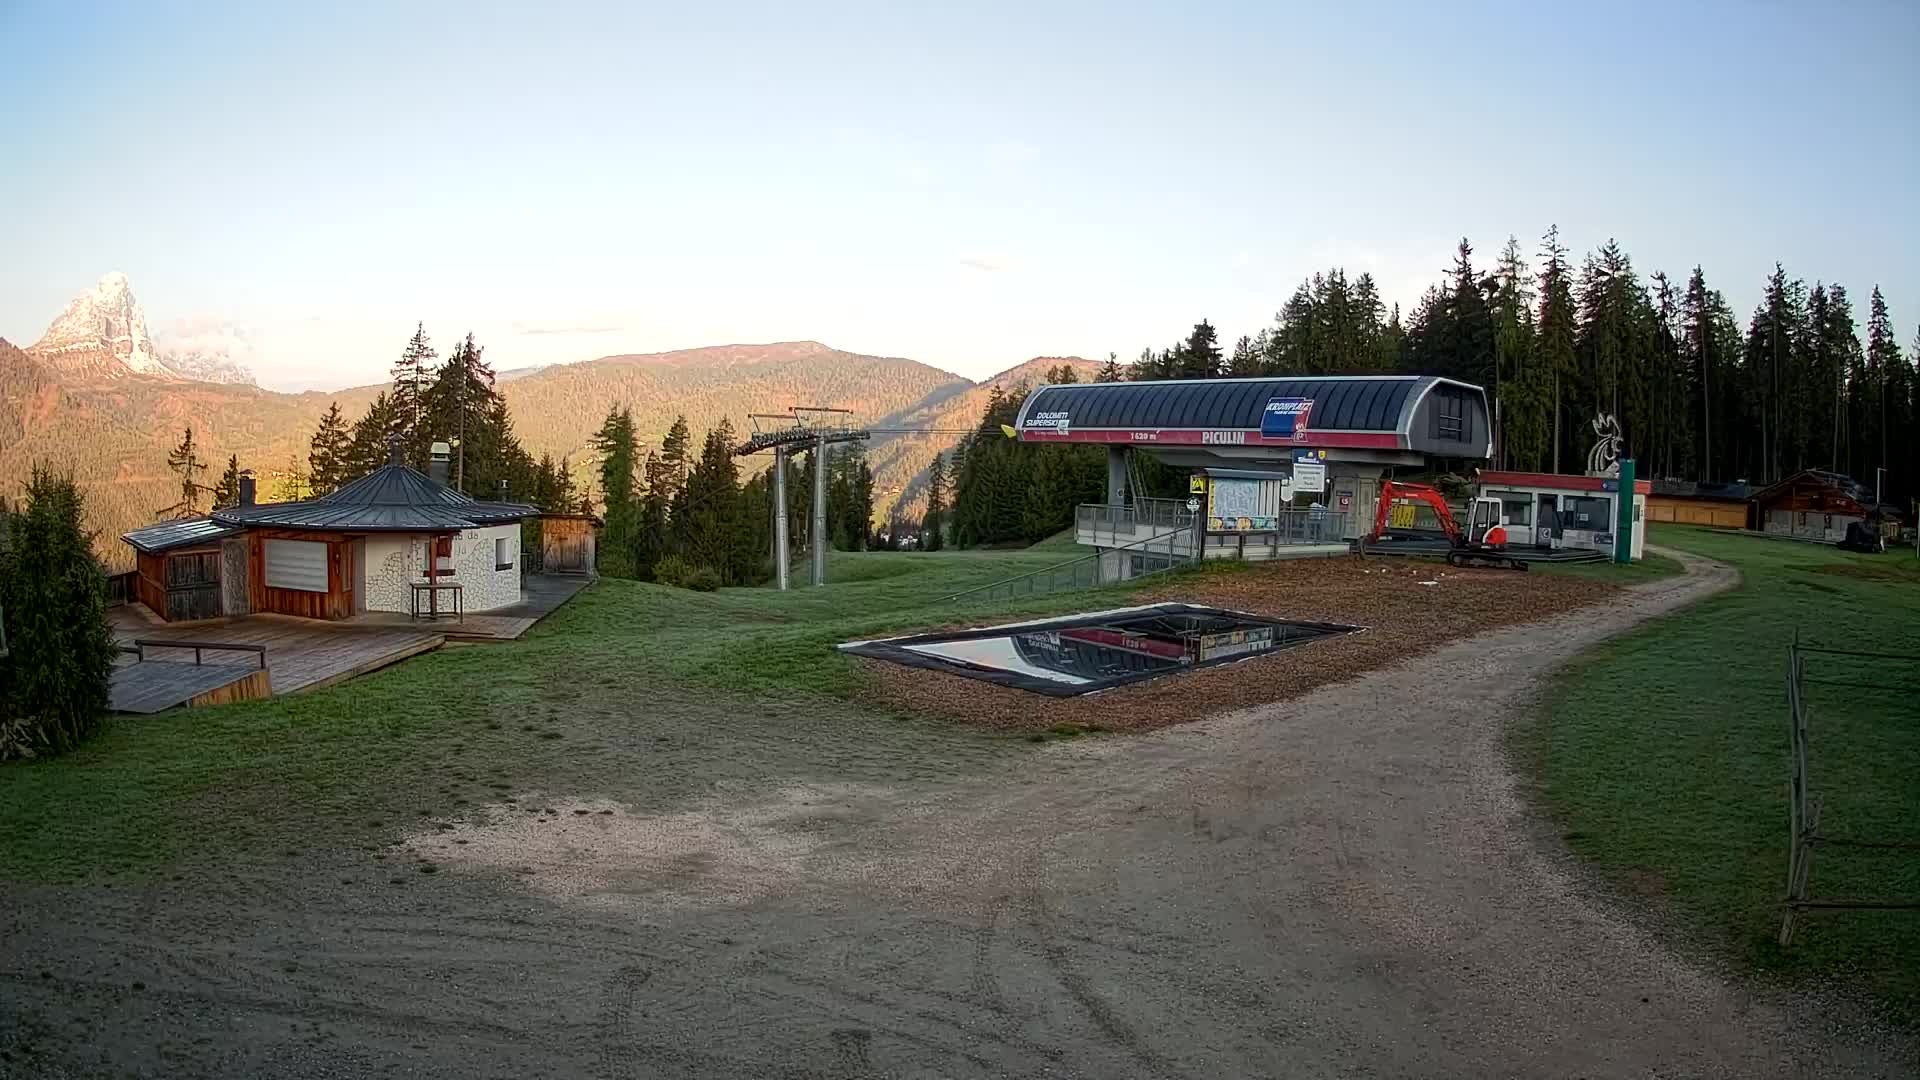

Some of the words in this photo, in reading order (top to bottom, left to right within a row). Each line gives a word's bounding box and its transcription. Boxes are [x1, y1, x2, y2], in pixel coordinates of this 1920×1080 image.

[1036, 411, 1069, 419] DOLOMITI
[1025, 419, 1058, 427] SUPERSKI
[1202, 431, 1245, 444] PICULIN
